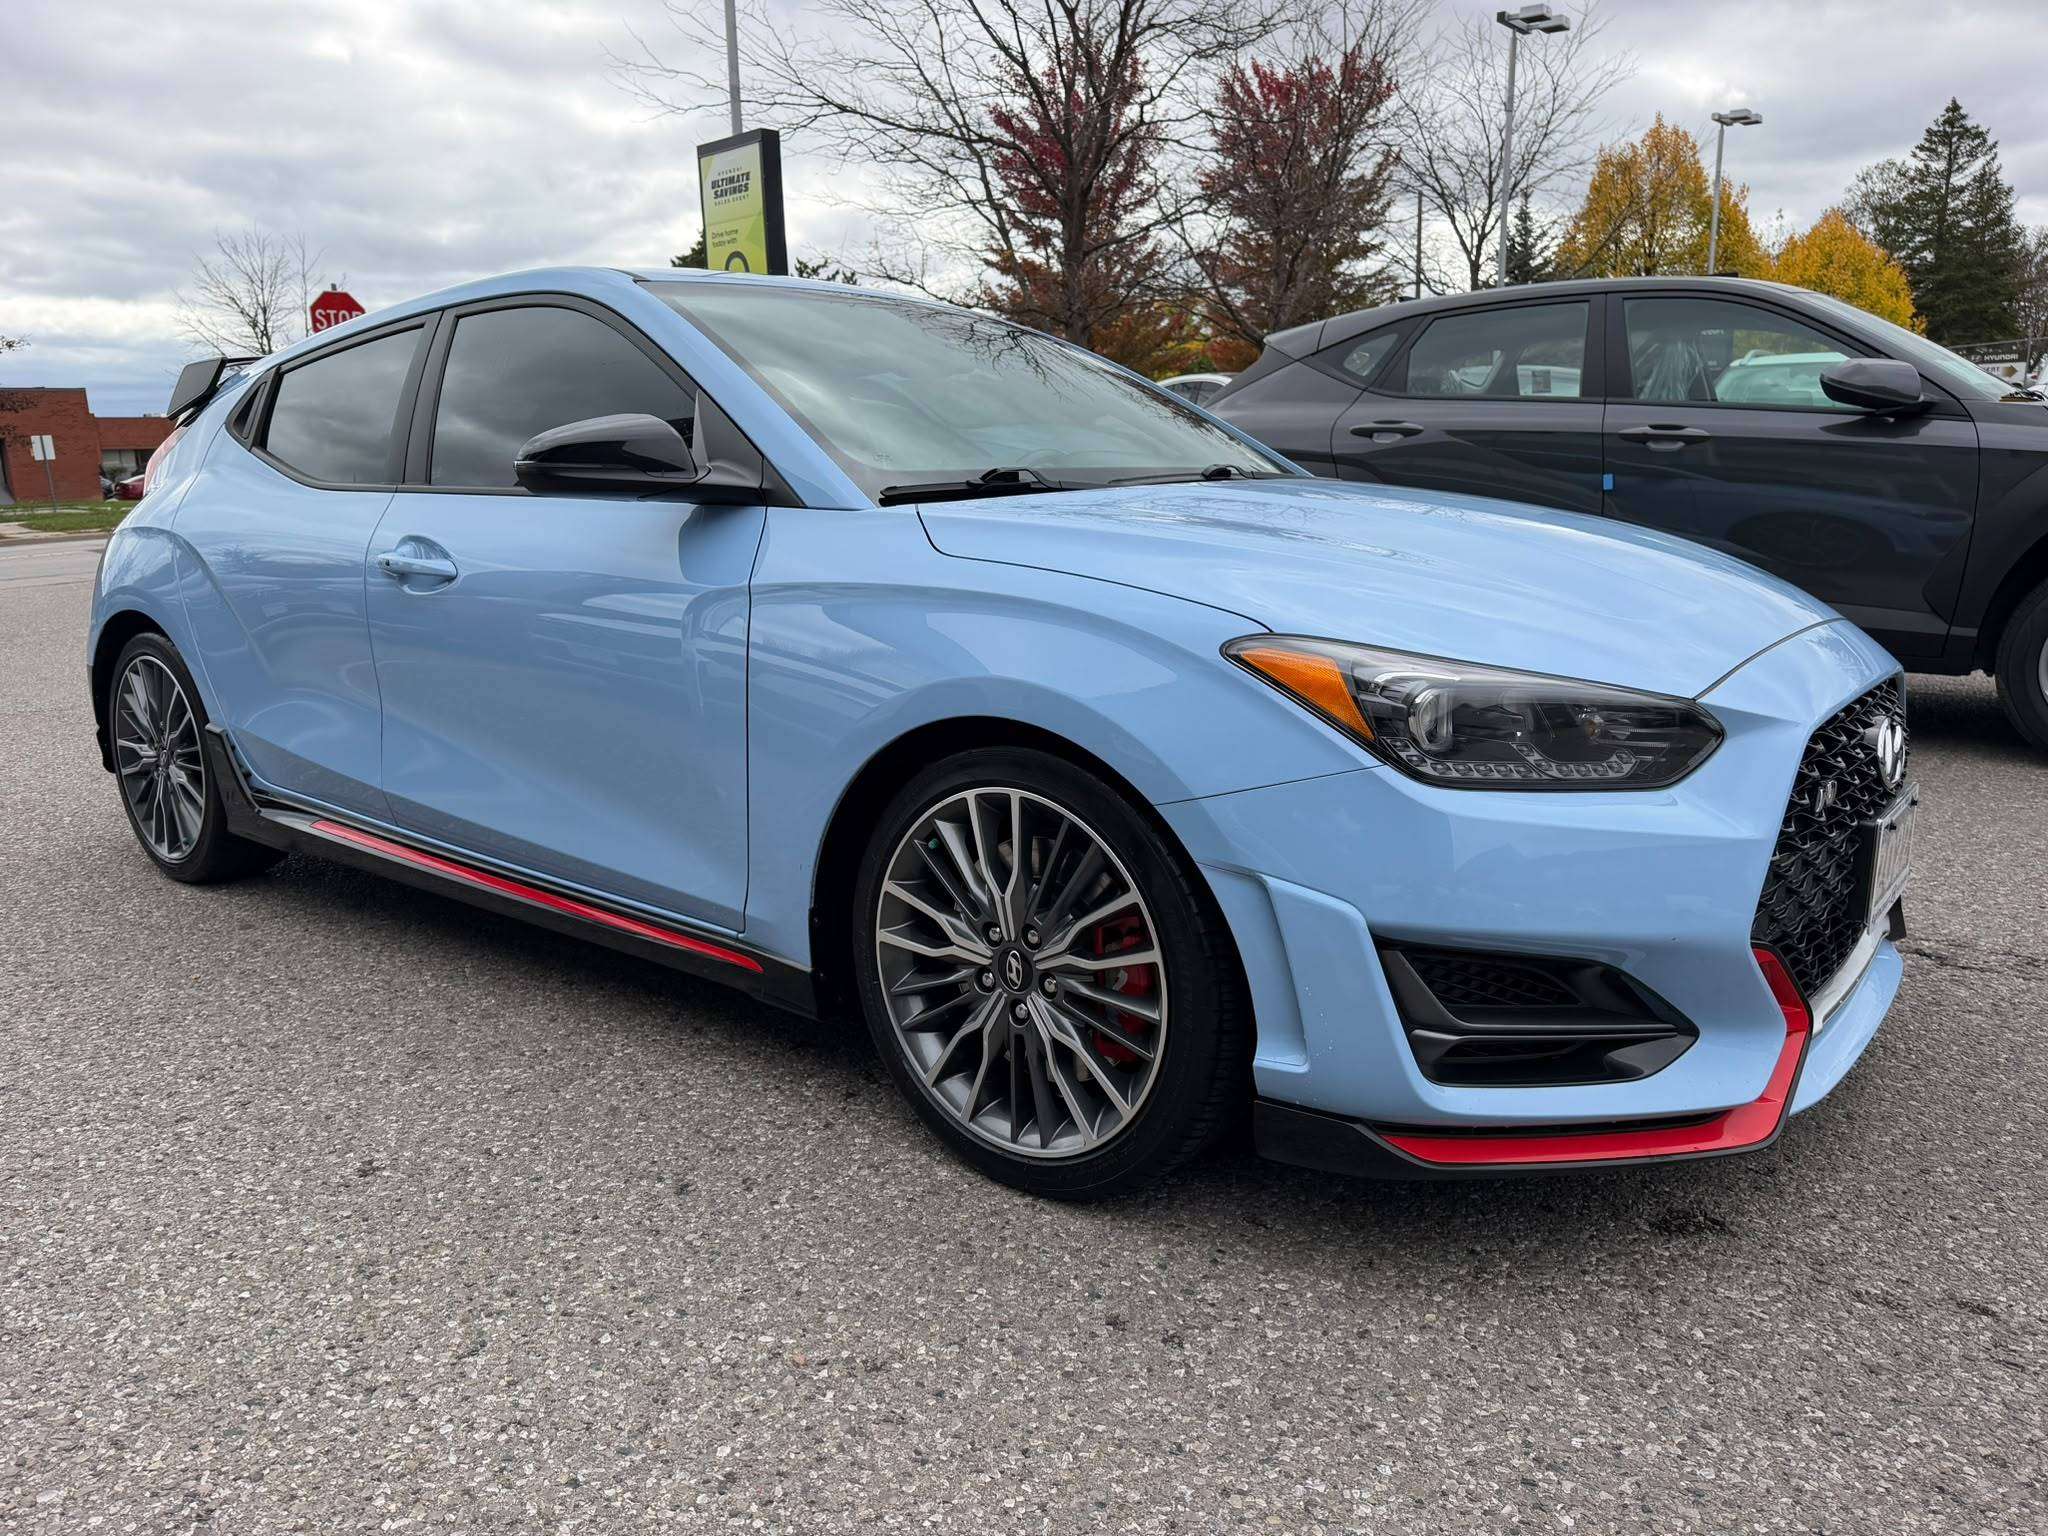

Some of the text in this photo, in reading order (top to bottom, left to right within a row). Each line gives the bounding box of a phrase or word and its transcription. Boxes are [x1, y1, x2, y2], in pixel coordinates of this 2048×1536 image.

[711, 172, 750, 190] ULTIMATE
[713, 182, 750, 200] SAVINGS
[1984, 353, 2019, 361] HYUNDAI
